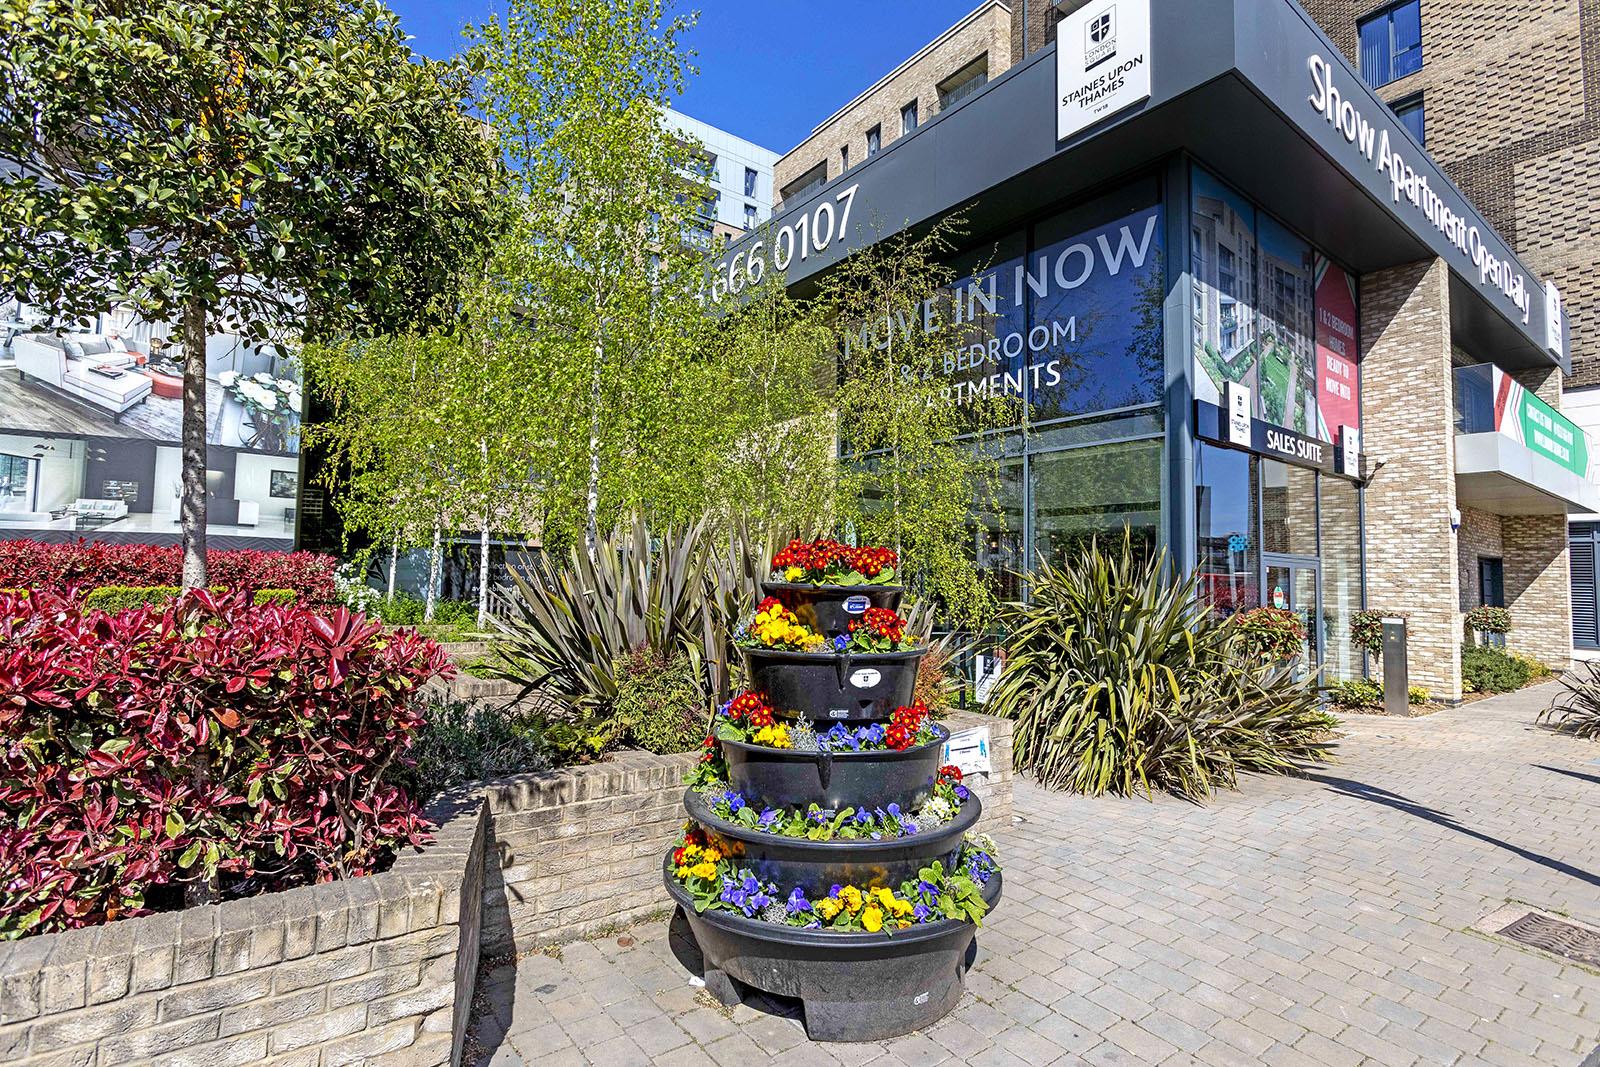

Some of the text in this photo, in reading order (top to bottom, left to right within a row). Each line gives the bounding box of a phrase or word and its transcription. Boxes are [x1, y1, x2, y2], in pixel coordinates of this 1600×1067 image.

[1085, 38, 1117, 61] LONDON
[1062, 54, 1144, 107] STAINES UPON
[1078, 76, 1125, 108] THAMES
[1093, 103, 1109, 114] TW18
[1307, 53, 1531, 326] Show Apartment Open Daily
[773, 182, 860, 272] 0107
[955, 271, 998, 325] IN
[1015, 214, 1158, 307] NOW
[943, 315, 1077, 375] BEDROOM
[1326, 355, 1342, 376] READY
[1266, 429, 1323, 464] SALES SUITE
